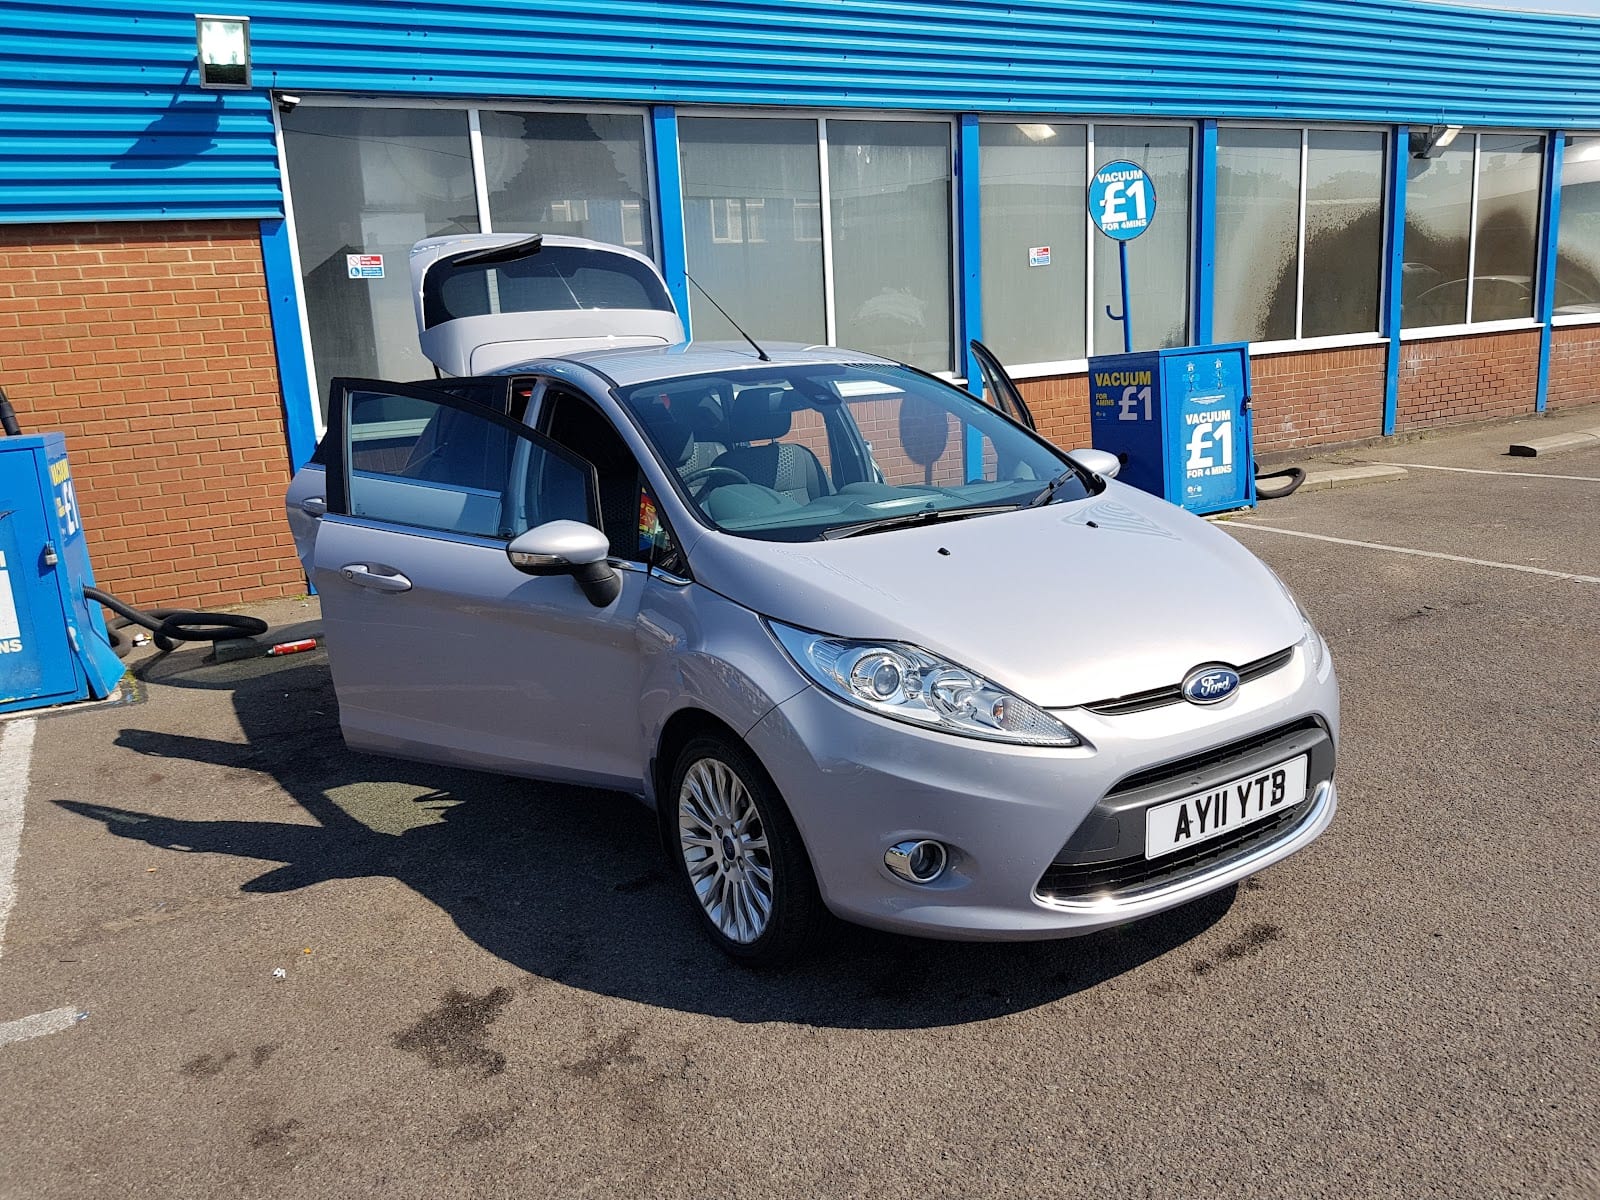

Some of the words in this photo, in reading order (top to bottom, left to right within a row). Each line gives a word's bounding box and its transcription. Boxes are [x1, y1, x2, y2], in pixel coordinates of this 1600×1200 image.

[1097, 169, 1143, 183] VACUUM
[1099, 180, 1147, 224] £1
[1102, 222, 1120, 232] FOR
[1095, 370, 1151, 386] VACUUM
[1118, 386, 1152, 420] £1
[1185, 409, 1231, 425] VACUUM
[1186, 421, 1232, 470] £1
[1186, 469, 1204, 479] FOR
[63, 480, 79, 535] £1
[1200, 674, 1230, 696] Ford
[1174, 790, 1228, 843] AY11
[1237, 769, 1286, 819] YTB
